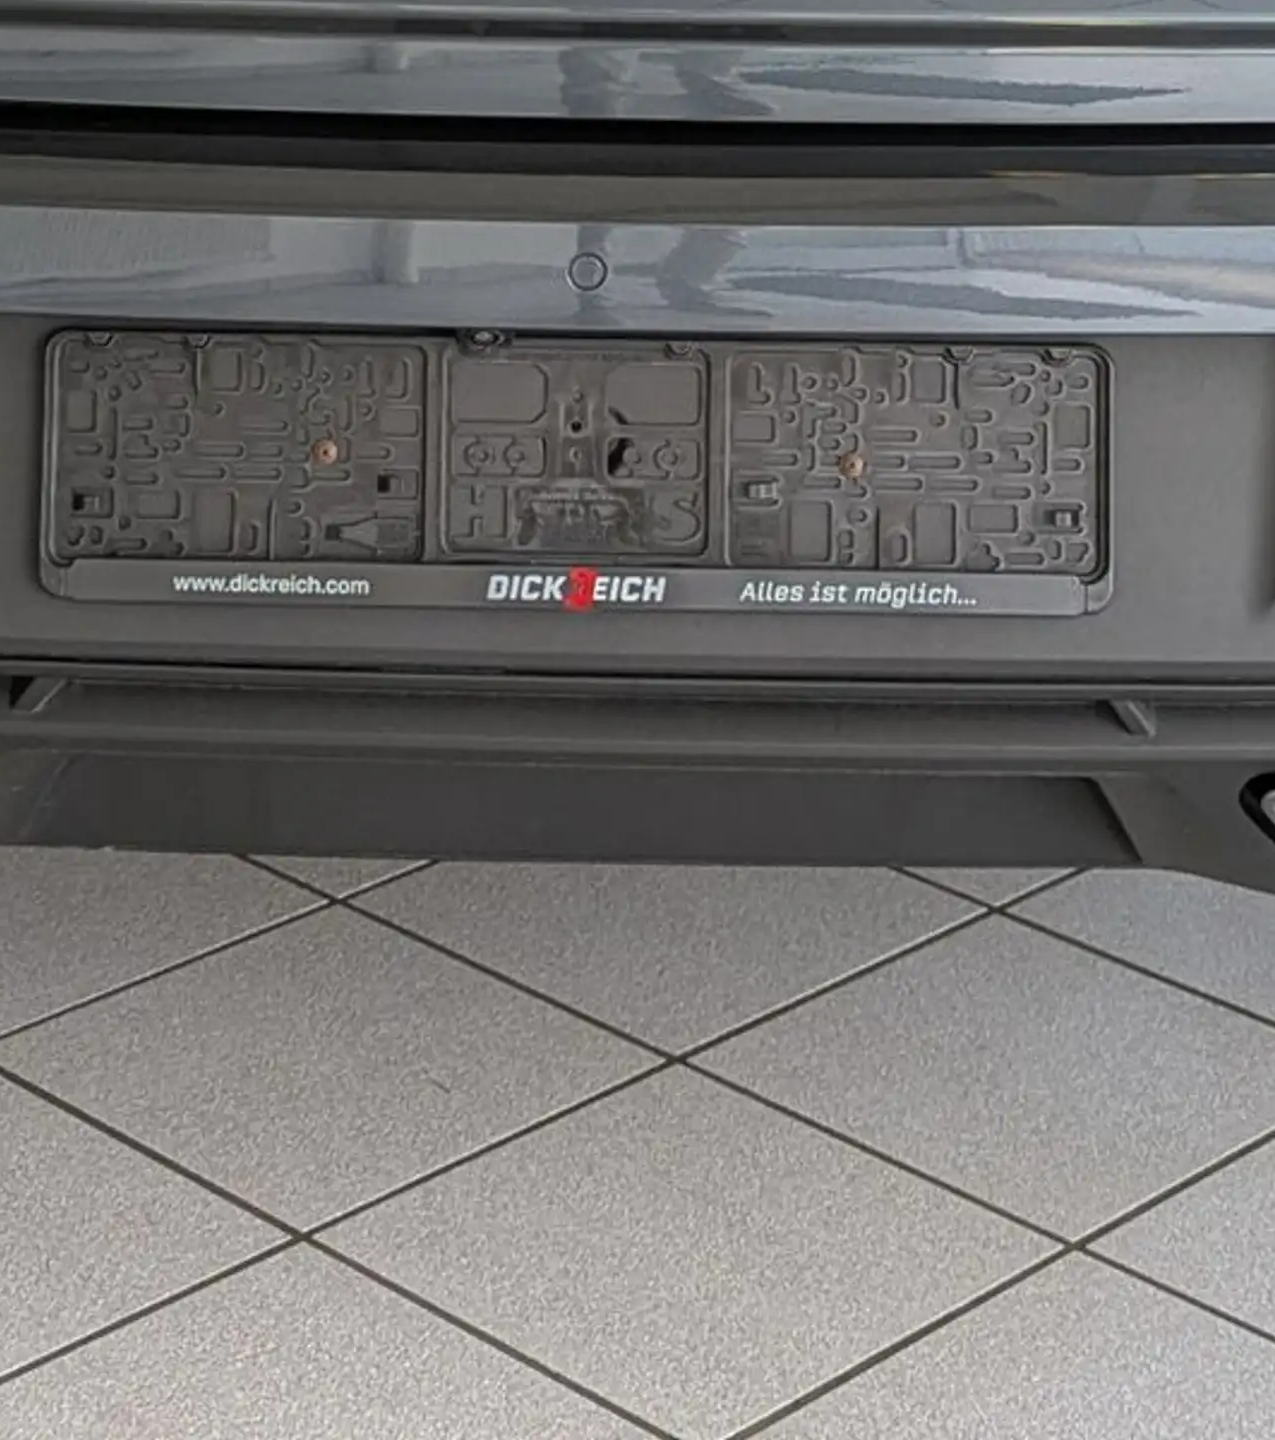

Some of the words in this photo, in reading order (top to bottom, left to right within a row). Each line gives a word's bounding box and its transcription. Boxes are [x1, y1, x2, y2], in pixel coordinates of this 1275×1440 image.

[173, 573, 371, 595] www.dickreich.com
[739, 581, 804, 602] Alles
[809, 581, 848, 603] ist
[854, 582, 977, 608] möglich...
